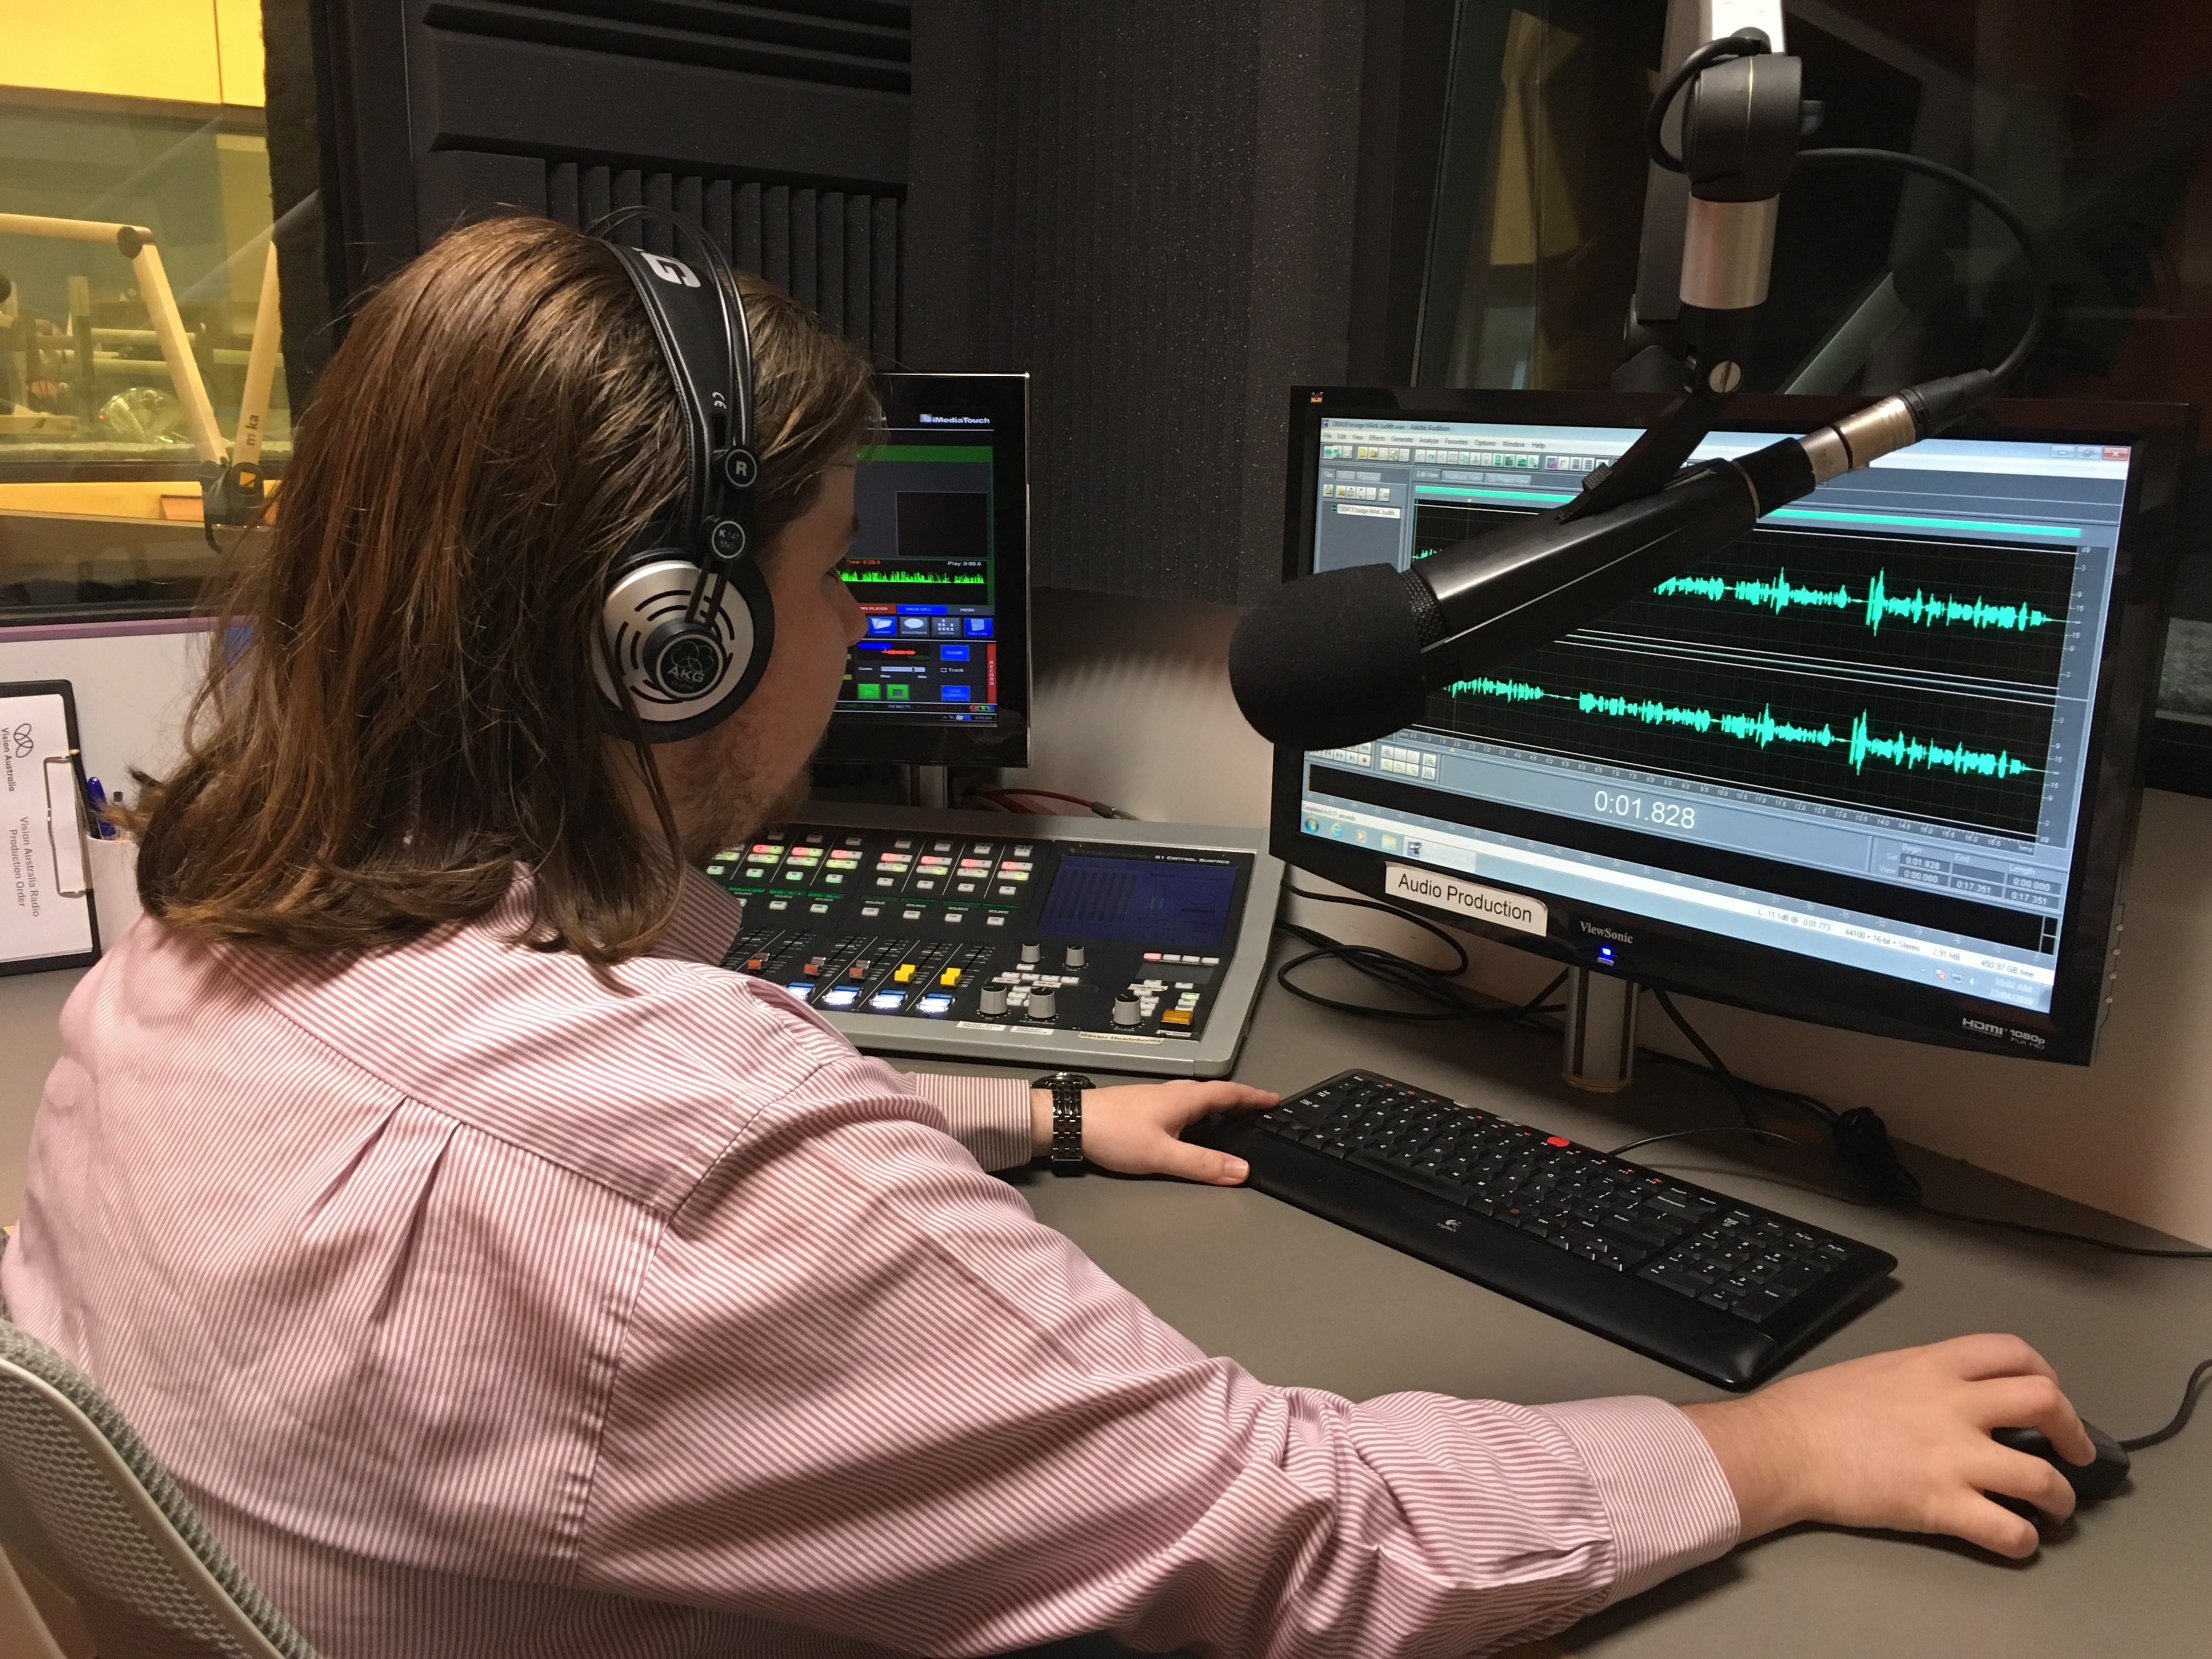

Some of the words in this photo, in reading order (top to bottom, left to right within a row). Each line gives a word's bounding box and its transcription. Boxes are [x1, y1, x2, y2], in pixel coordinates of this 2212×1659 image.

[736, 460, 747, 476] R
[667, 665, 705, 682] AKG
[2, 727, 10, 752] Vision
[5, 755, 16, 792] Australia
[1594, 791, 1695, 829] 0:01.828
[20, 816, 30, 845] Vision
[1886, 853, 1898, 861] Sel
[1902, 843, 1922, 854] Begin
[1954, 853, 1970, 863] End
[2010, 864, 2035, 876] Length
[2018, 844, 2033, 853] hms
[9, 829, 22, 878] Production
[16, 881, 26, 907] Order
[24, 848, 36, 888] Australia
[1878, 865, 1896, 874] View
[1956, 881, 1991, 894] 0:17.351
[30, 890, 41, 917] Radio
[1398, 873, 1442, 898] Audio
[1447, 885, 1532, 923] Production
[1580, 921, 1633, 944] ViewSonic
[1845, 929, 1866, 939] 44100
[1873, 935, 1891, 945] 16-bit
[1899, 940, 1920, 952] Stereo
[1932, 948, 1946, 957] 2.91
[1949, 952, 1960, 961] MB
[1980, 960, 2005, 971] 450.97
[2007, 965, 2018, 974] GB
[2019, 969, 2034, 978] free
[2017, 984, 2033, 993] AM
[1962, 1017, 2004, 1035] HDMI
[2010, 1029, 2046, 1045] 1080p
[2011, 1037, 2027, 1045] Full
